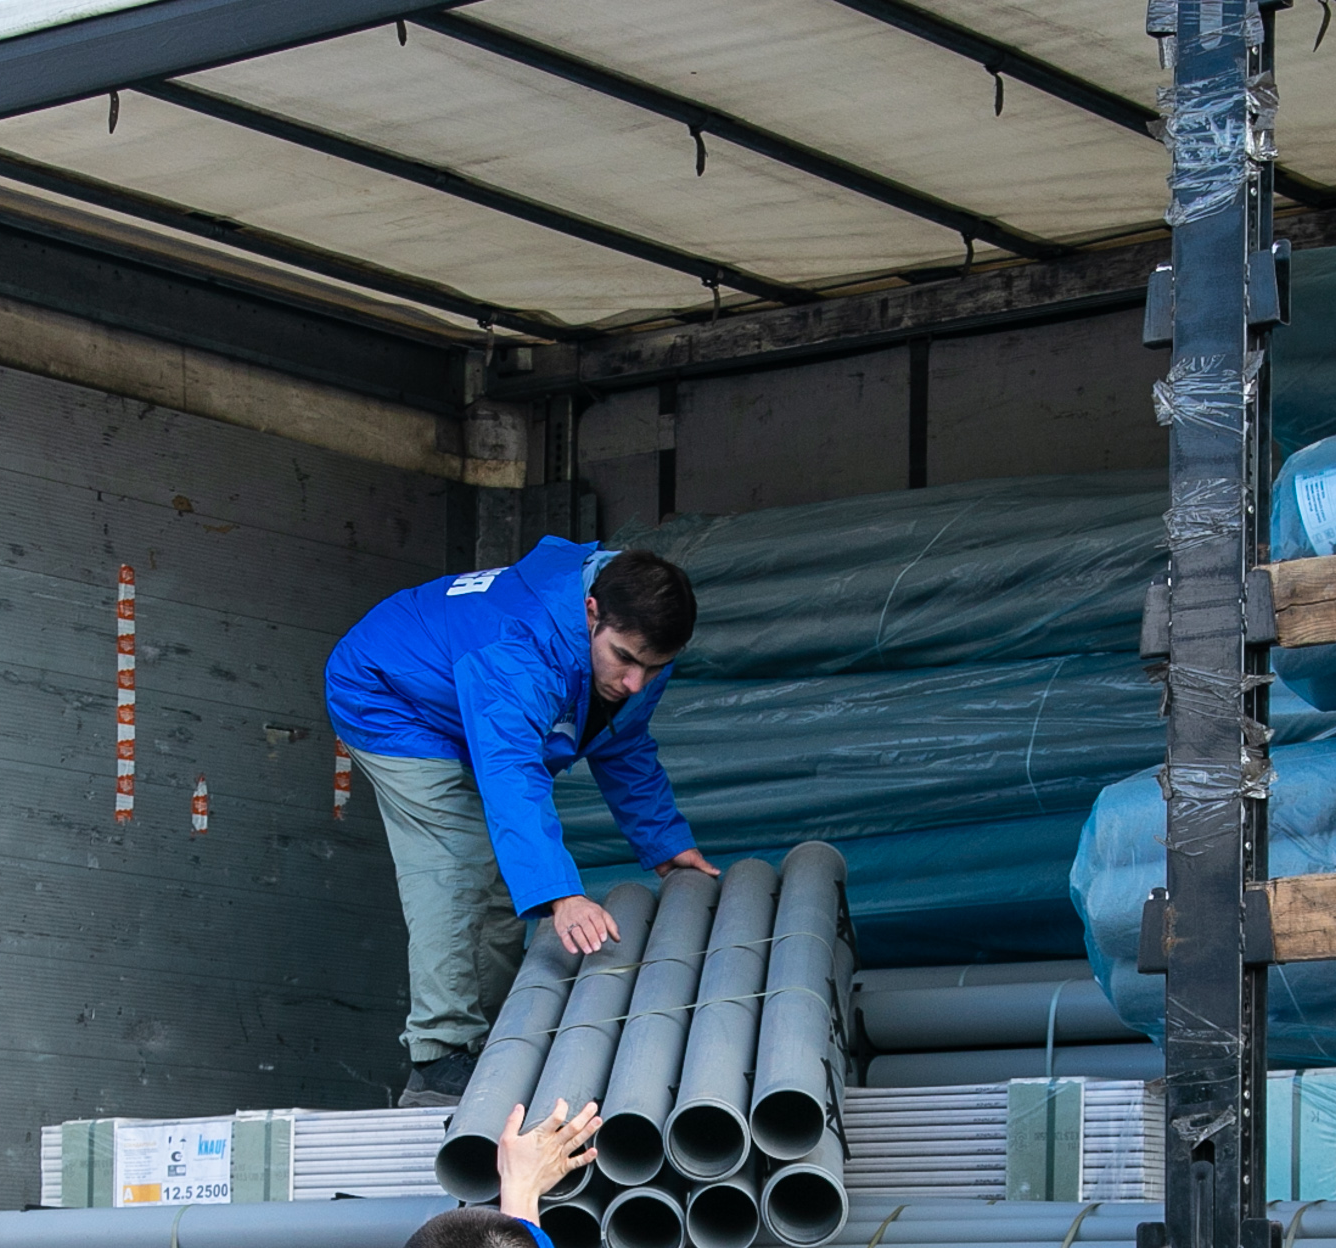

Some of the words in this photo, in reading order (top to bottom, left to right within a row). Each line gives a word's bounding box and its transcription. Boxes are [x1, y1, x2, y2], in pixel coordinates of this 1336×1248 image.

[198, 1134, 227, 1159] KNAUF
[164, 1186, 193, 1200] 12.5
[196, 1184, 228, 1198] 2500
